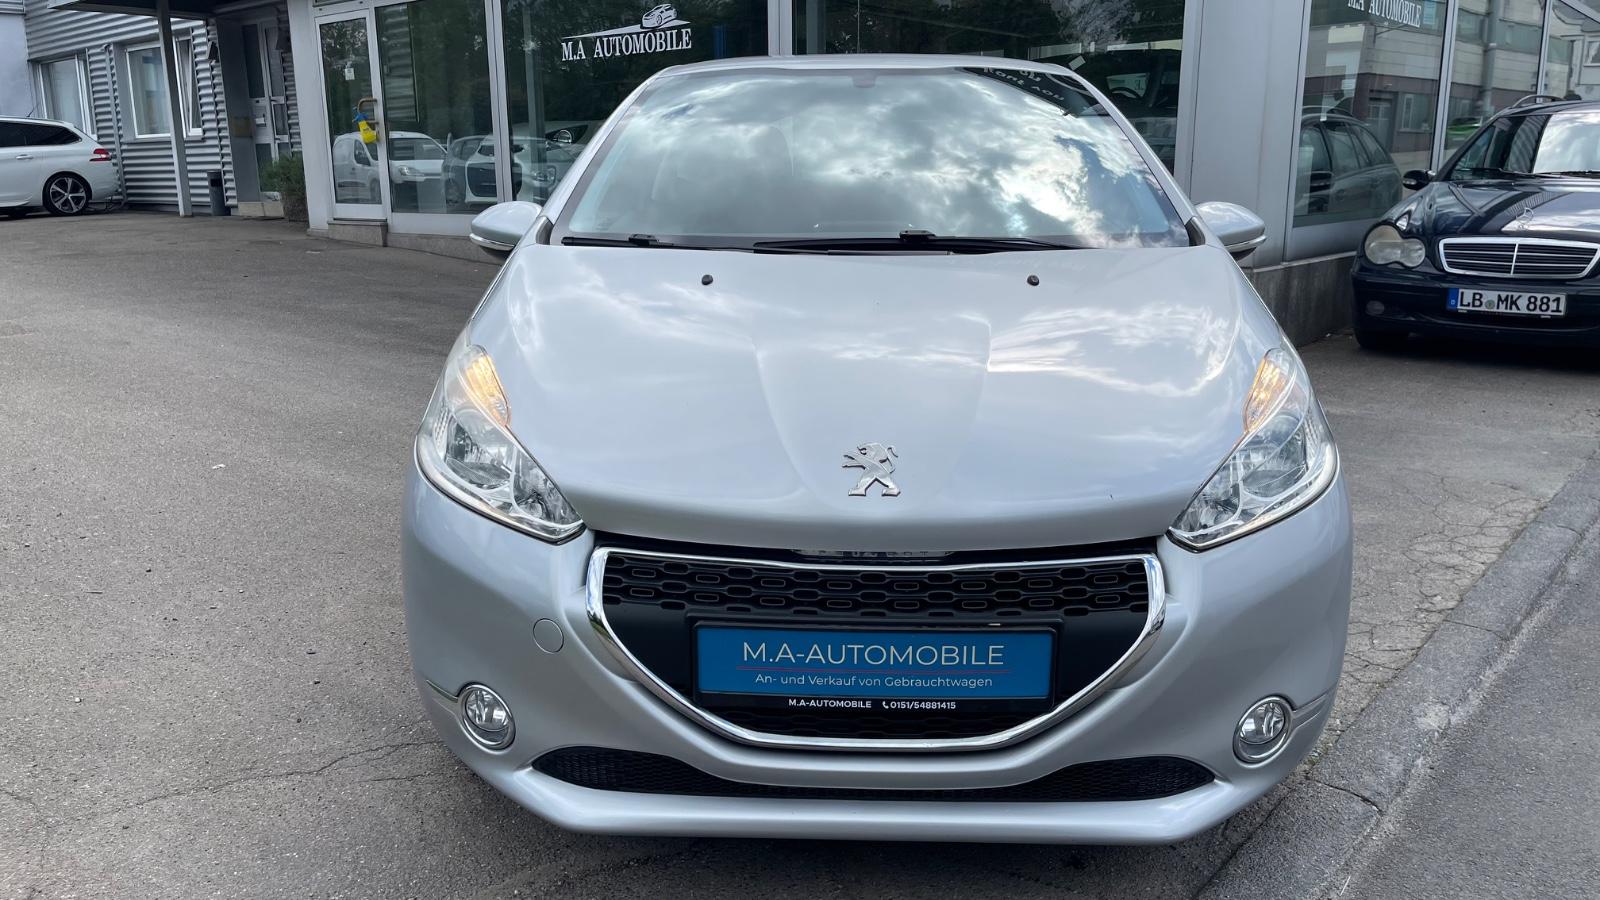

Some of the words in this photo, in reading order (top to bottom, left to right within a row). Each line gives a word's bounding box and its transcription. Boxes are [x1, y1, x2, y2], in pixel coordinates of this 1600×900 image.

[561, 40, 586, 61] M.A
[594, 28, 692, 58] AUTOMOBILE
[1459, 291, 1483, 308] LB
[1496, 294, 1522, 311] MK
[1526, 295, 1562, 313] 881
[743, 641, 1005, 666] M.A-AUTOMOBILE
[755, 673, 777, 684] An-
[781, 674, 805, 685] und
[808, 675, 856, 686] Verkauf
[858, 678, 881, 687] von
[884, 676, 993, 689] Gebrauchtwagen
[788, 698, 872, 709] M.A-AUTOMOBILE
[890, 700, 957, 710] 0151/54881415
